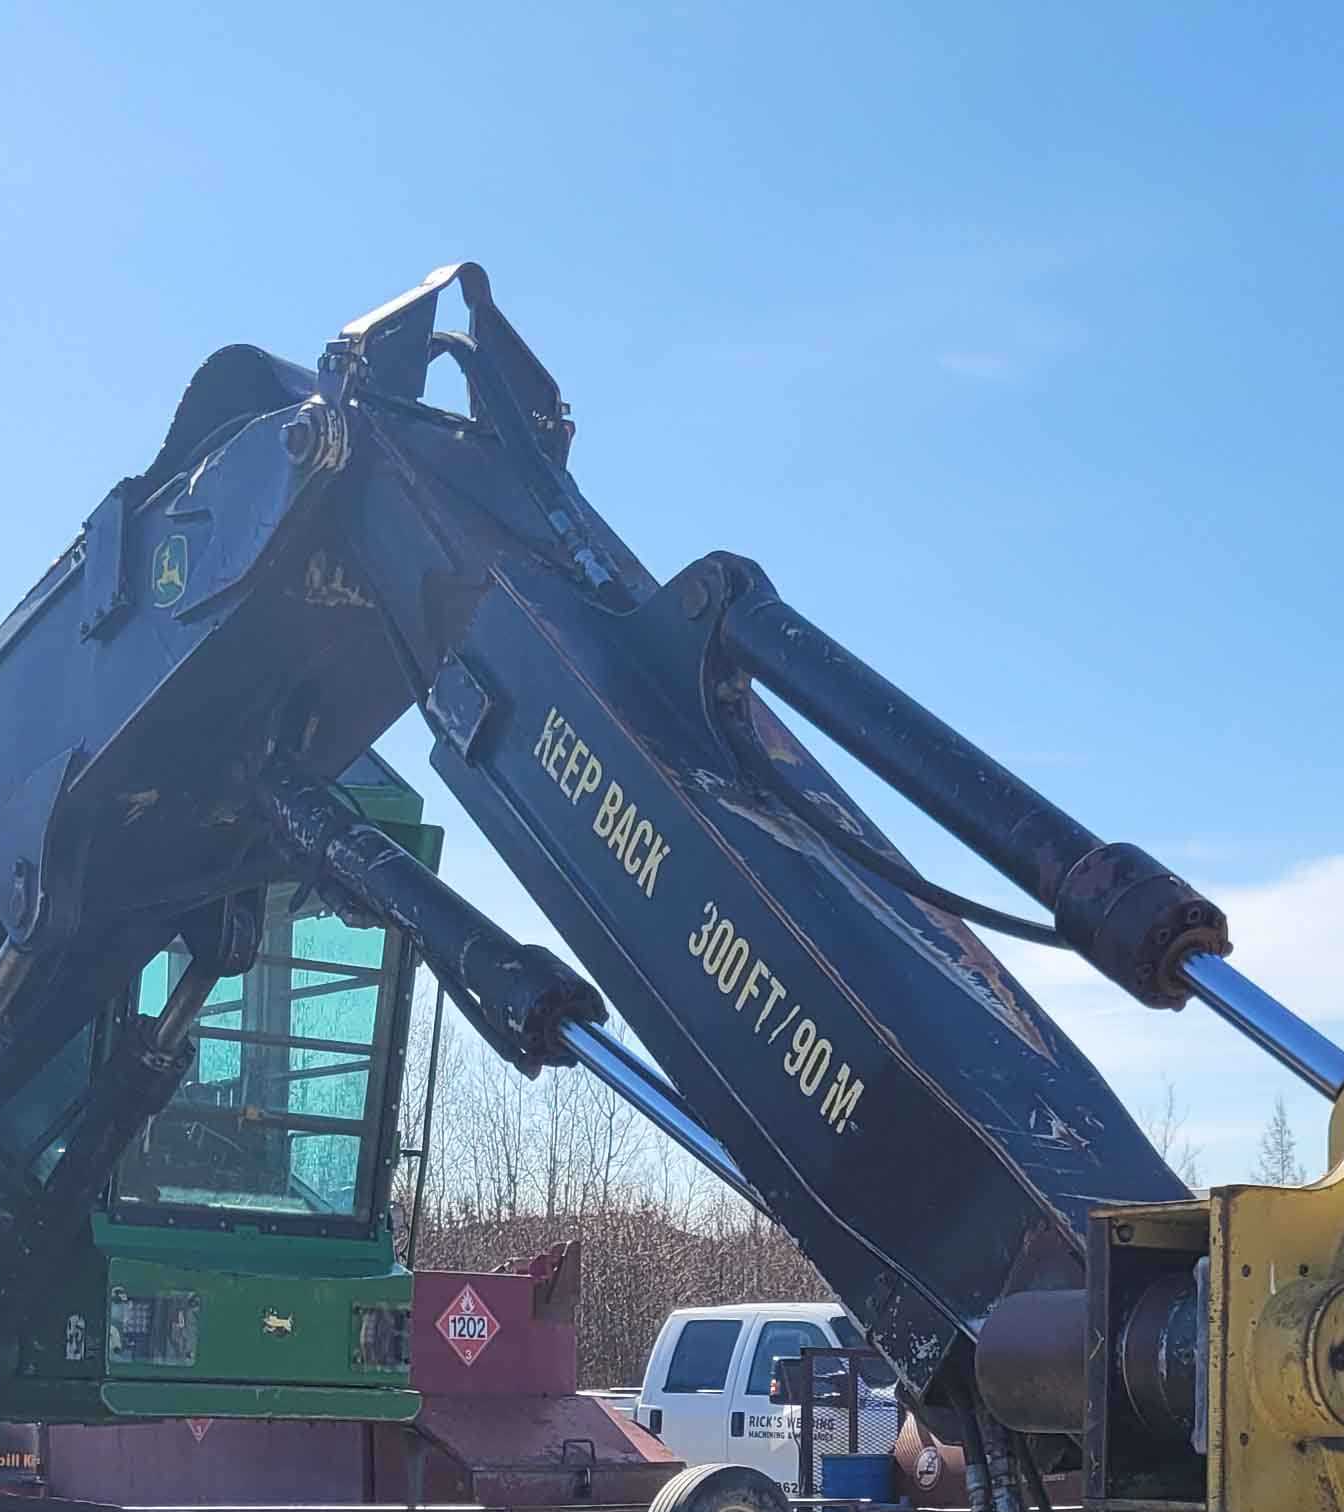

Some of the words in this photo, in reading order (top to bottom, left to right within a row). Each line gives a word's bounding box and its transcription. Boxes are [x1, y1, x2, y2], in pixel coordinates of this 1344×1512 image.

[533, 705, 603, 806] KEEP
[592, 779, 672, 899] BACK
[450, 1316, 486, 1338] 1202
[464, 1349, 473, 1361] 3
[748, 1415, 783, 1428] RICK'S
